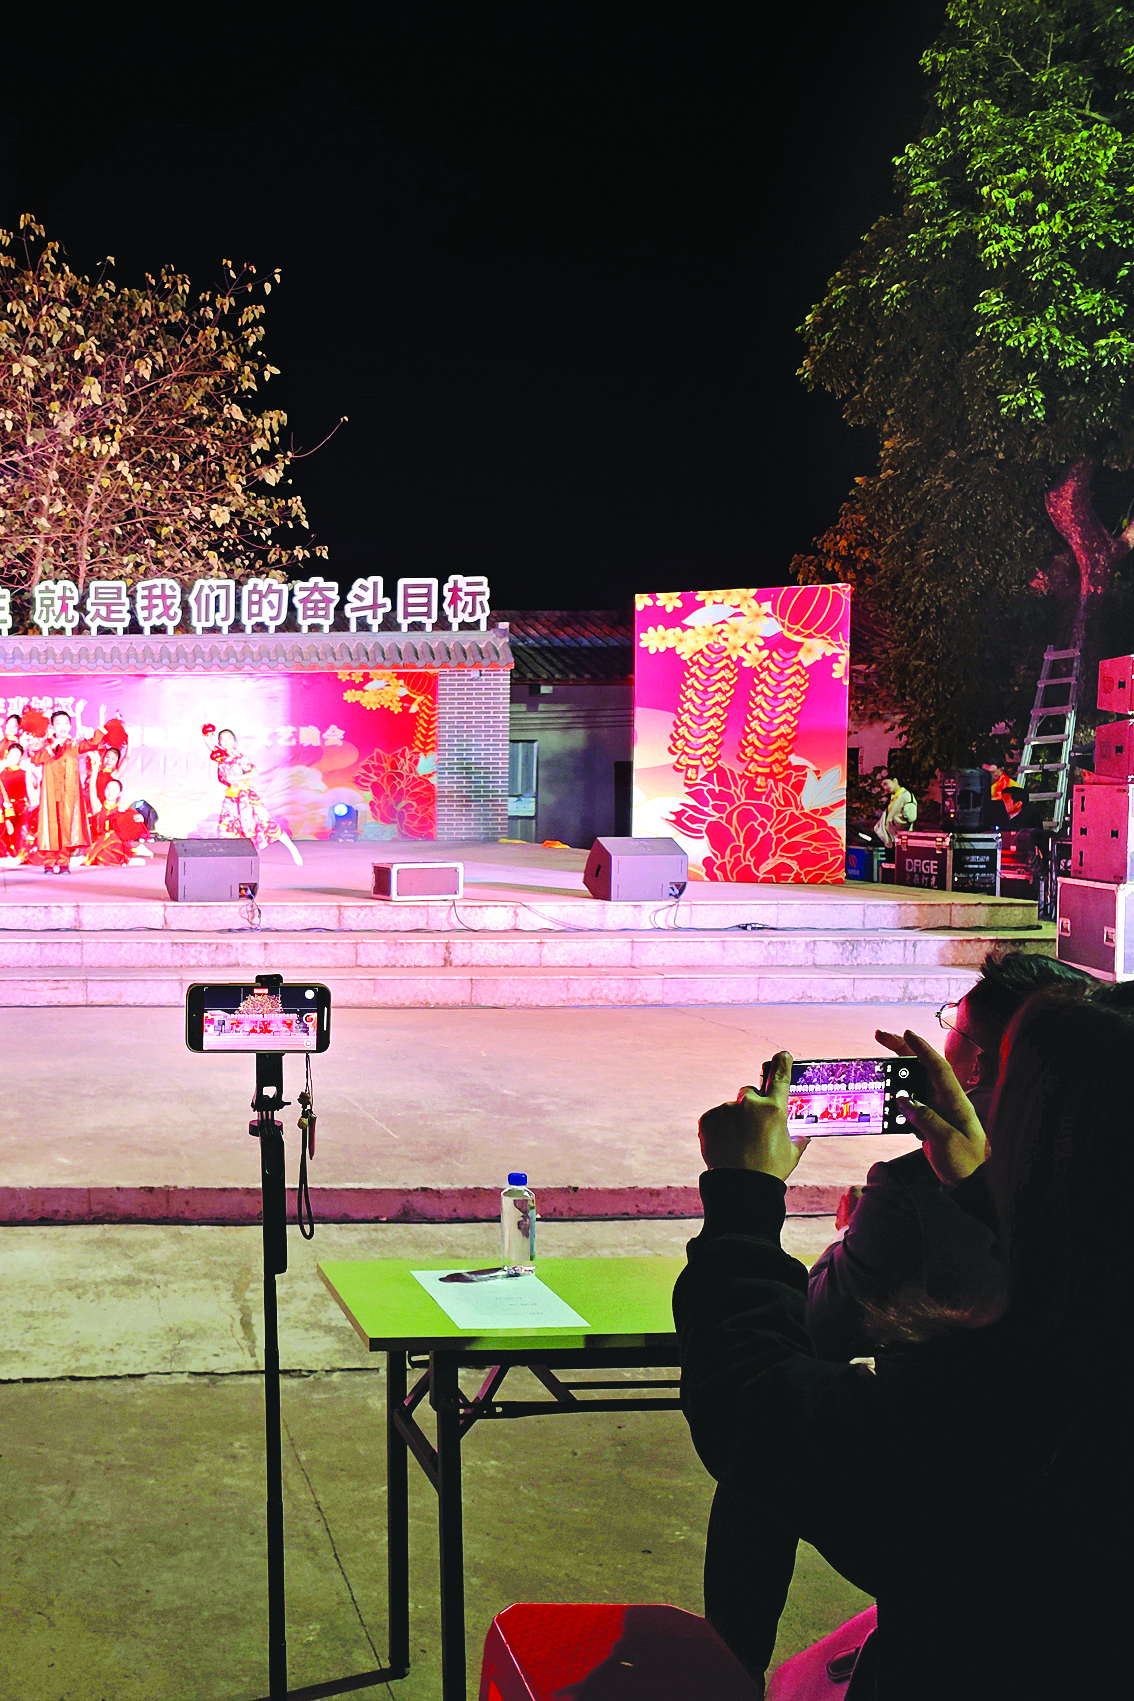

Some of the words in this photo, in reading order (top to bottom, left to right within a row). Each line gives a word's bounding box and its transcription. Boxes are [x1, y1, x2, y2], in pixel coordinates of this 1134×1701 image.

[34, 575, 491, 631] 就是我们的奋斗目标
[905, 858, 939, 875] DAGE
